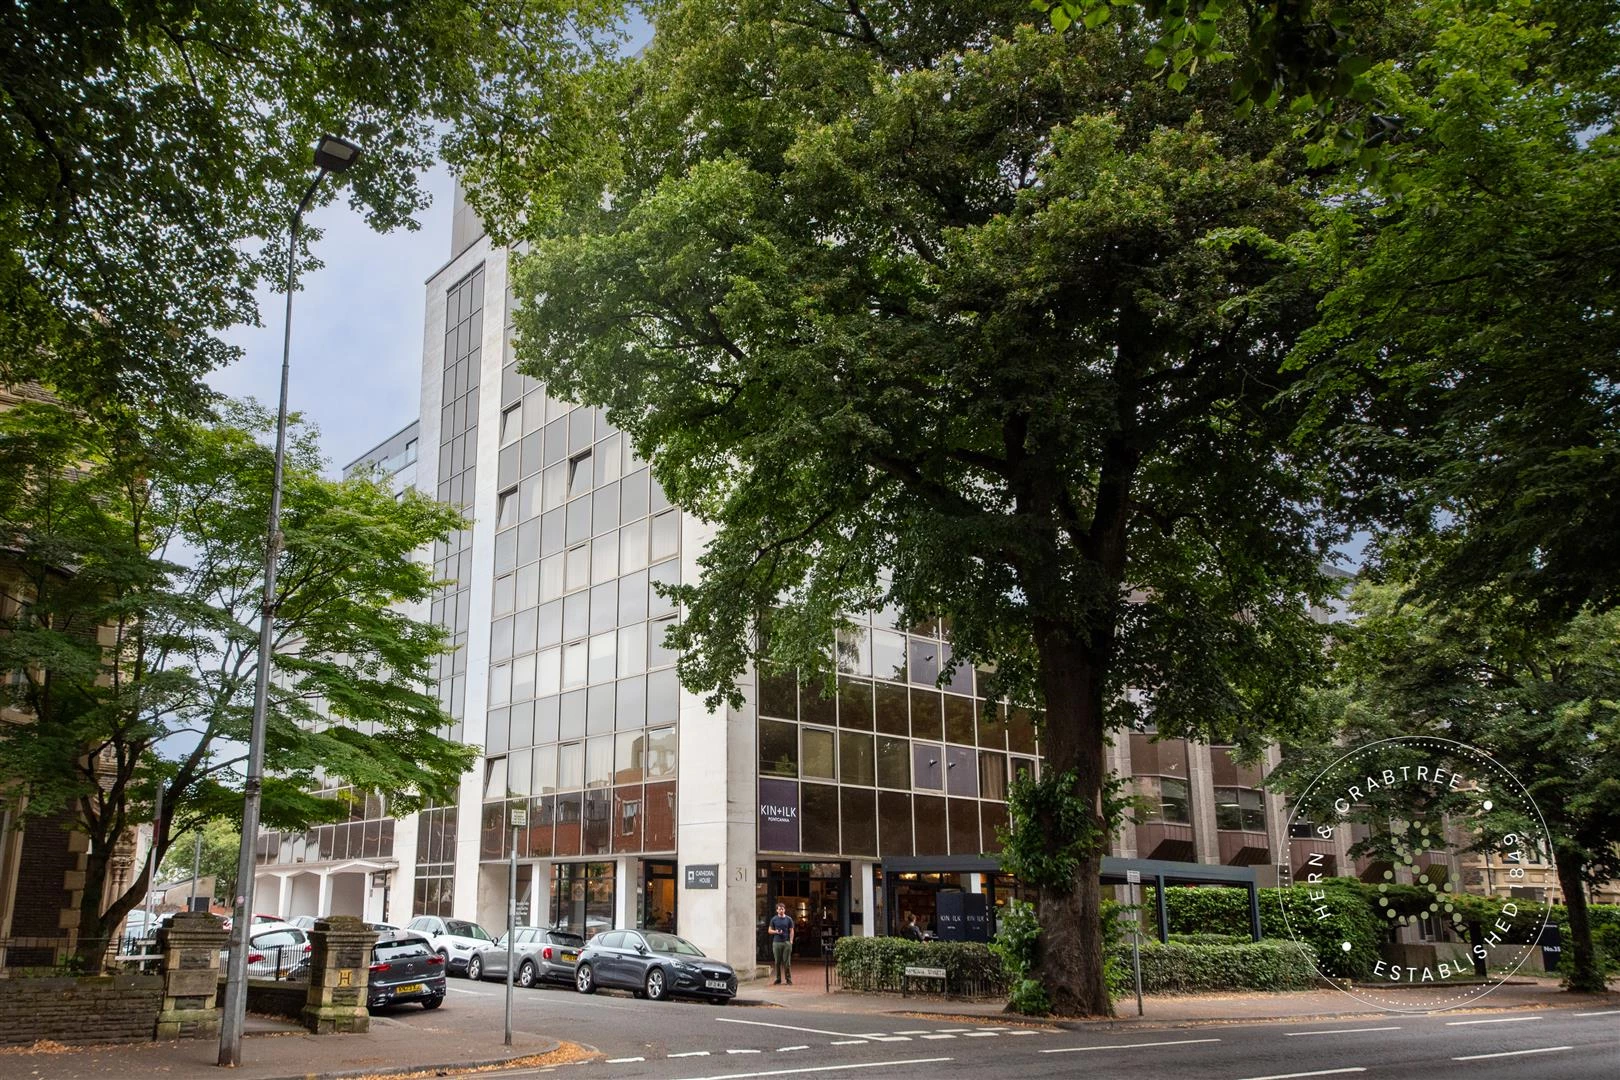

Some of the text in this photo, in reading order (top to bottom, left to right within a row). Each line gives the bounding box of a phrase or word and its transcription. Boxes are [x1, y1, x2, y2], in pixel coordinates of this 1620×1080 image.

[760, 804, 797, 818] KIN+ILK
[735, 866, 748, 882] 31
[338, 971, 353, 987] H
